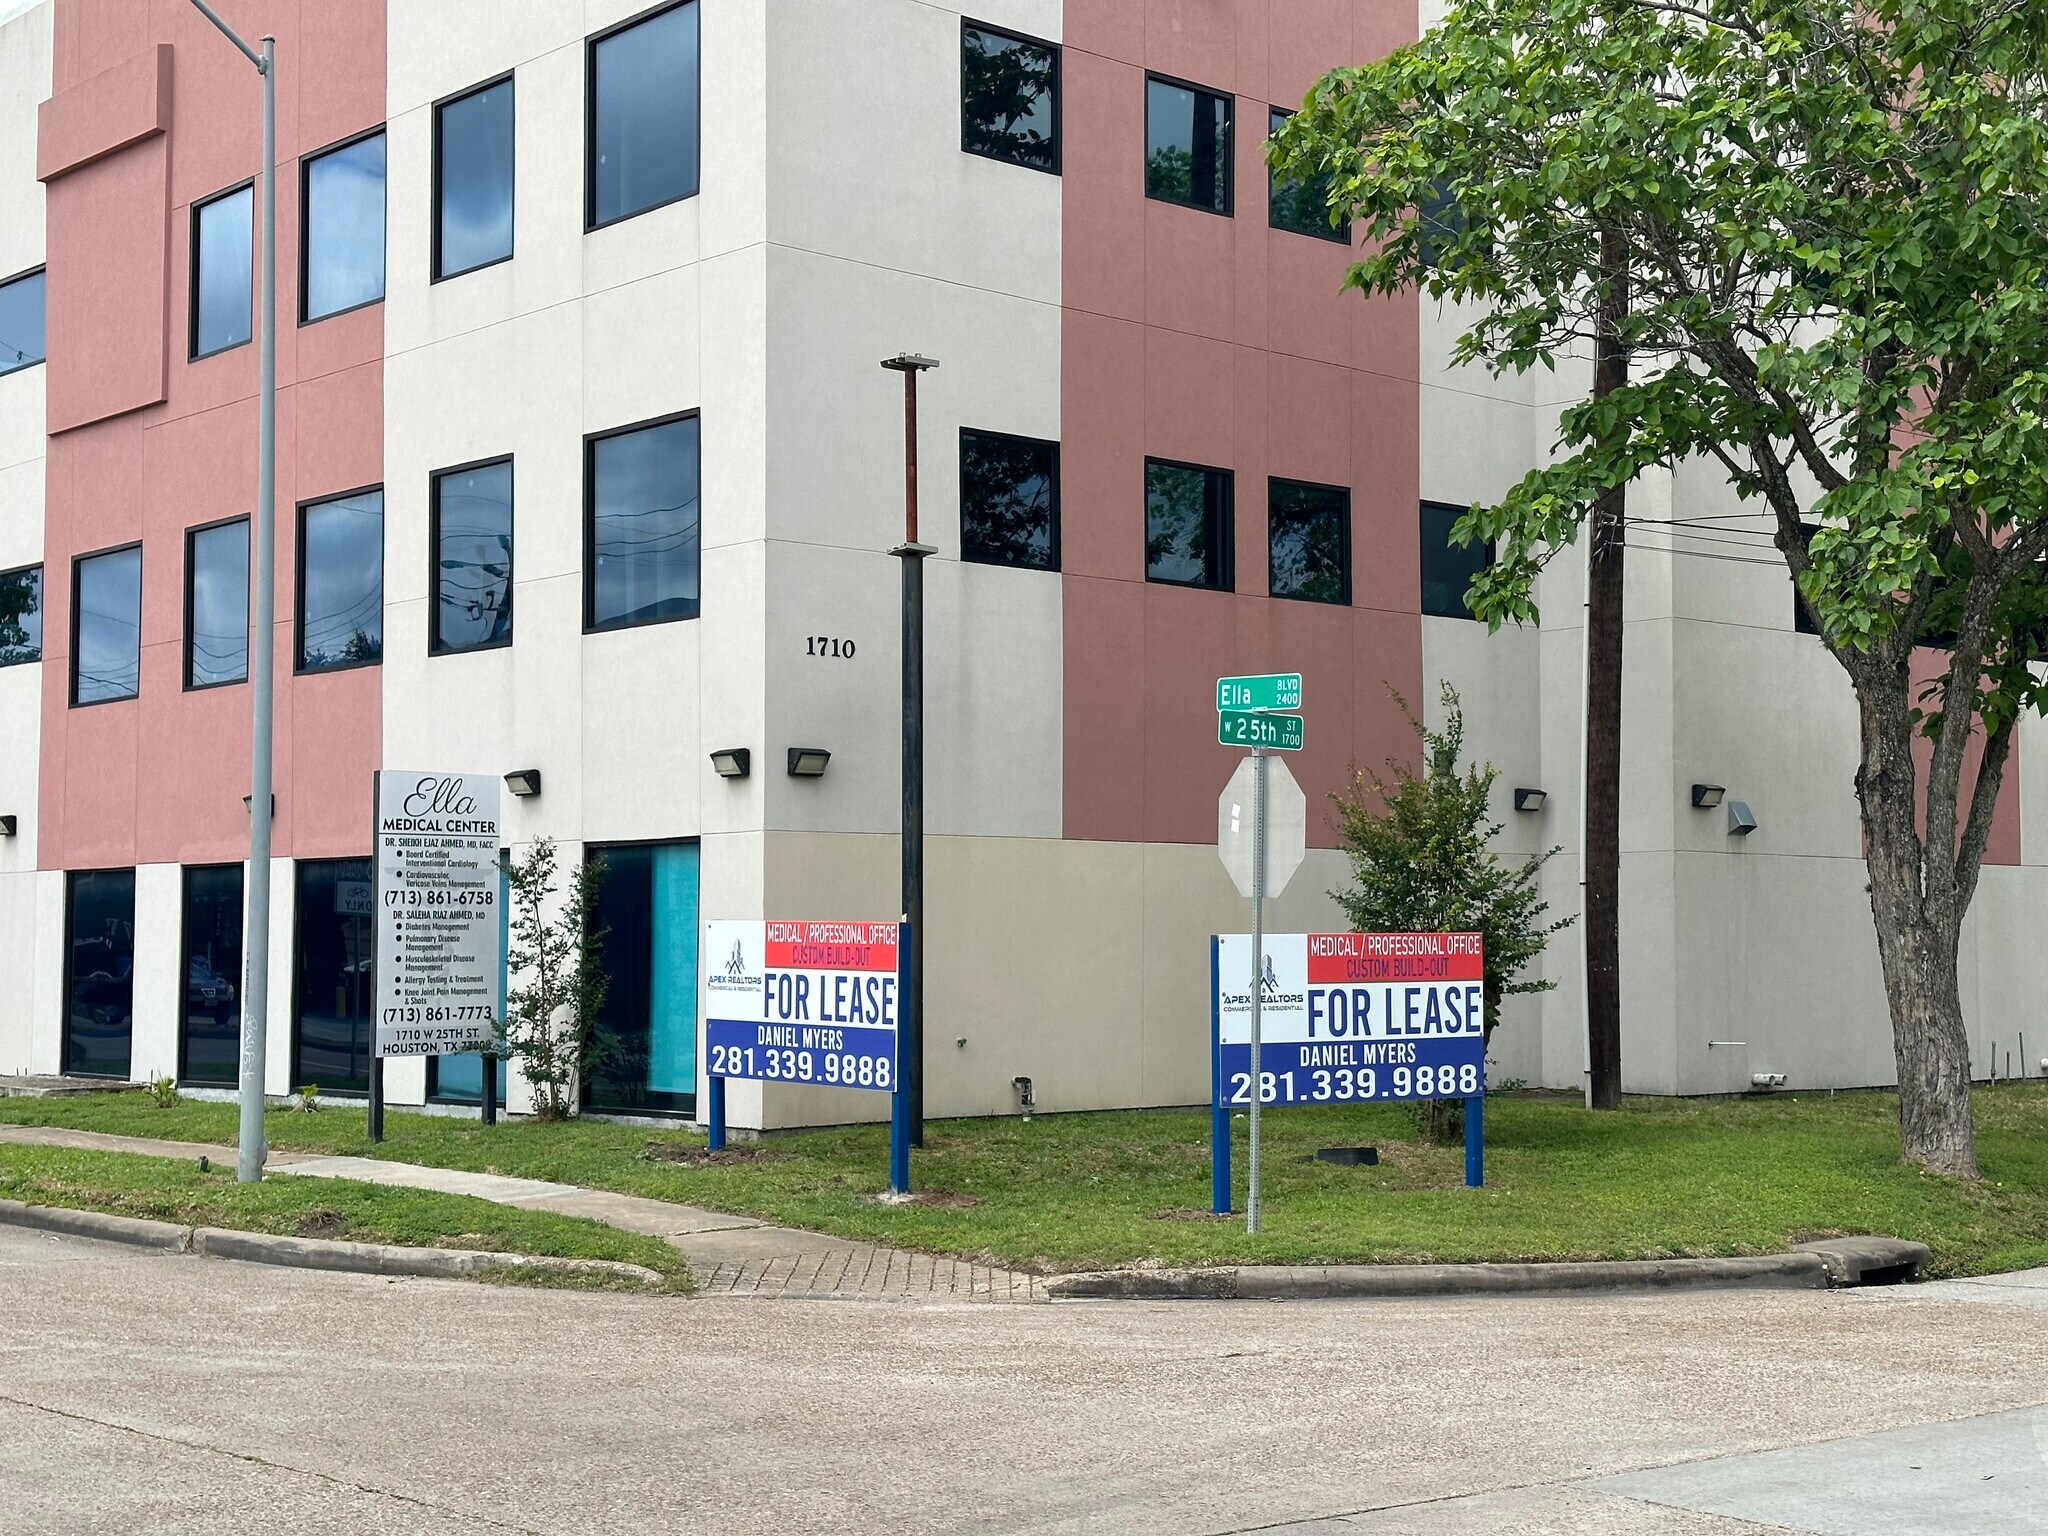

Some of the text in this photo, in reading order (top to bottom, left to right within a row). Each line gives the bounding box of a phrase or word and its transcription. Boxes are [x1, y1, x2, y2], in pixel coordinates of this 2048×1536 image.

[807, 636, 855, 658] 1710
[1221, 679, 1297, 705] Ella BLVD
[1276, 693, 1297, 704] 2400
[1225, 718, 1296, 742] W 25th ST
[1282, 733, 1299, 746] 1700
[404, 777, 477, 817] Ella
[383, 819, 496, 833] MEDICAL CENTER
[385, 838, 494, 849] DR. SHEIKH EJAZ AHMED, MD, FACC
[406, 850, 450, 859] Board Certified
[406, 859, 479, 869] Interventional Cardiology
[406, 879, 486, 890] Varicose Veins Management
[385, 890, 493, 907] (713) 861-6758
[393, 911, 404, 919] DR.
[406, 911, 431, 919] SALEHA
[433, 911, 447, 919] RIAZ
[449, 911, 474, 920] AHMED,
[406, 923, 469, 932] Diabetes Management
[767, 923, 802, 943] MEDICAL
[809, 924, 867, 944] PROFESSIONAL
[869, 925, 896, 945] OFFICE
[406, 935, 460, 944] Pulmonary Disease
[1311, 938, 1358, 956] MEDICAL
[1368, 936, 1444, 955] PROFESSIONAL
[1447, 935, 1480, 955] OFFICE
[406, 943, 443, 952] Management
[405, 955, 451, 963] Musculoskeletal
[792, 947, 870, 966] CUSTOM BUILD-OUT
[405, 964, 443, 973] Management
[1346, 957, 1449, 978] CUSTOM BUILD-OUT
[405, 976, 426, 985] Allergy
[427, 976, 447, 985] Testing
[455, 975, 483, 983] Treatment
[709, 975, 762, 984] APEX REALTORS
[420, 988, 435, 996] Joint
[437, 988, 449, 996] Pain
[451, 988, 487, 997] Management
[764, 973, 895, 1025] FOR LEASE
[1223, 994, 1304, 1004] APEX EALTORS
[411, 997, 427, 1005] Shots
[383, 1006, 492, 1025] (713) 861-7773
[1308, 986, 1481, 1037] FOR LEASE
[396, 1028, 479, 1040] 1710 W 25TH ST.
[757, 1025, 843, 1051] DANIEL MYERS
[383, 1042, 440, 1054] HOUSTON,
[444, 1041, 458, 1051] TX
[1300, 1042, 1416, 1067] DANIEL MYERS
[712, 1045, 890, 1088] 281.339.9888
[1230, 1064, 1477, 1104] 281.339.9888
